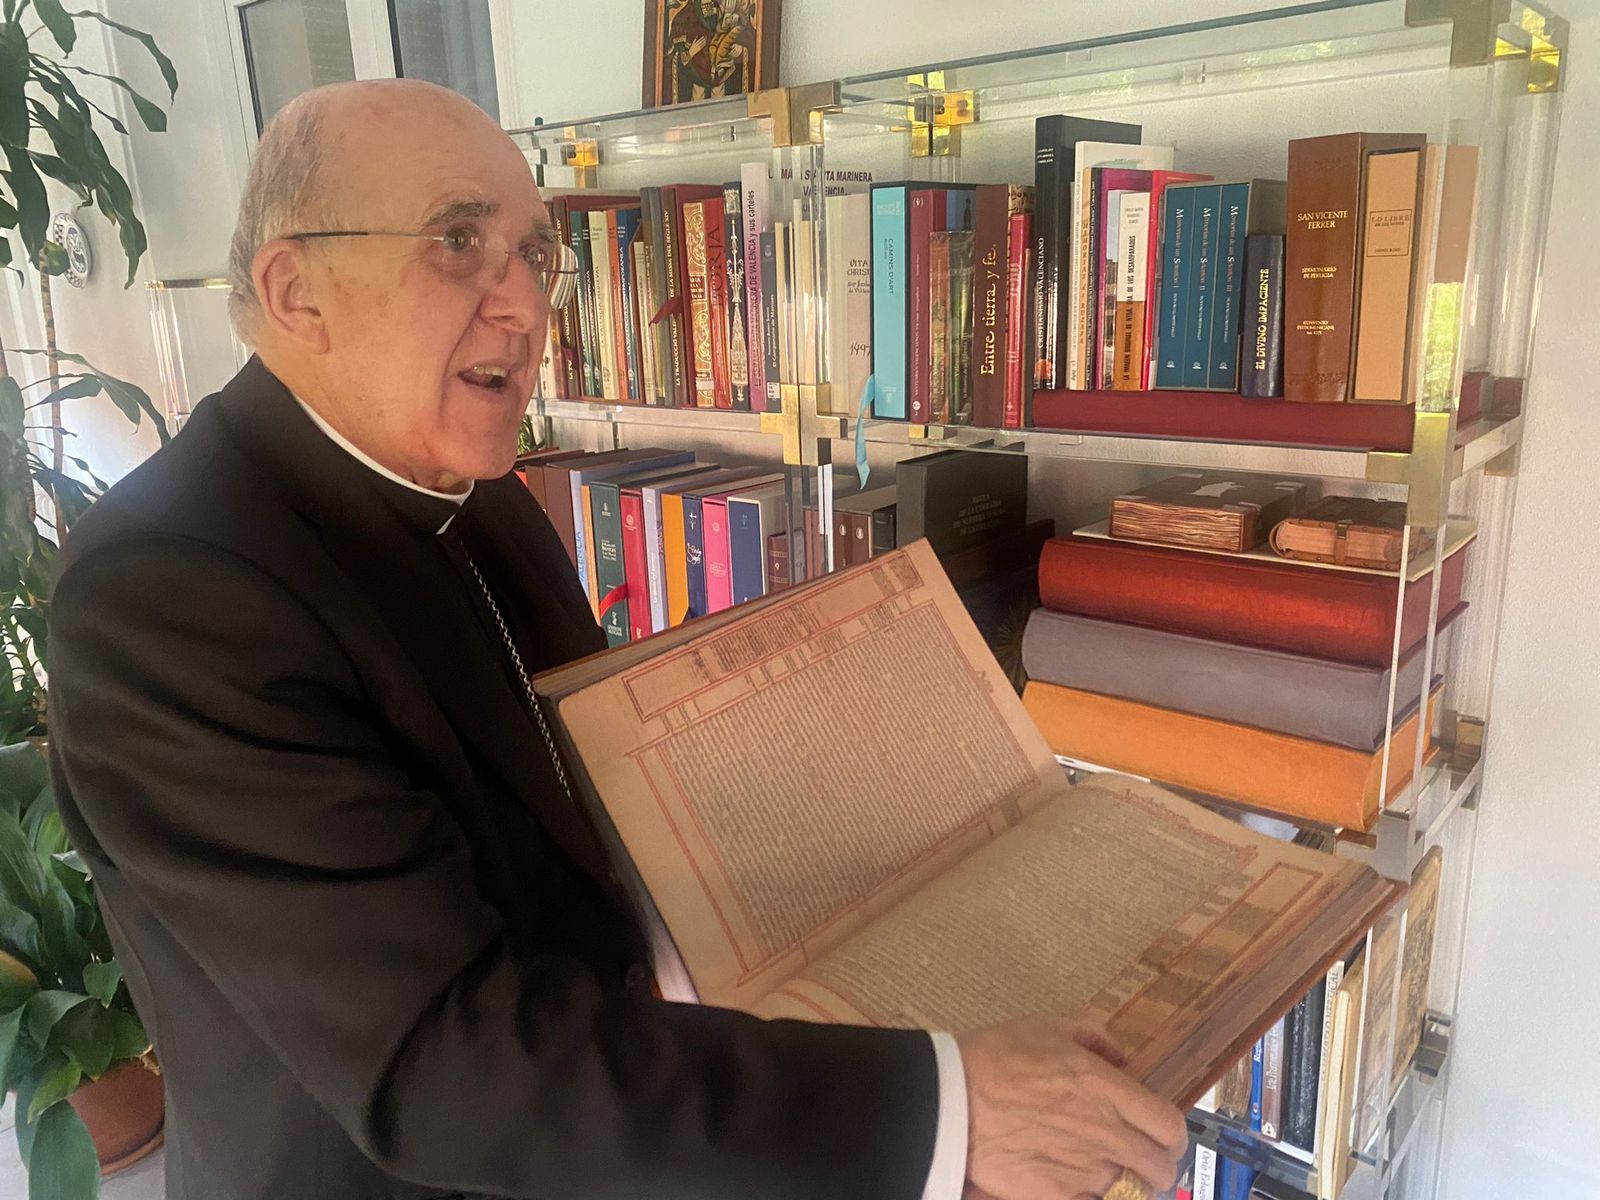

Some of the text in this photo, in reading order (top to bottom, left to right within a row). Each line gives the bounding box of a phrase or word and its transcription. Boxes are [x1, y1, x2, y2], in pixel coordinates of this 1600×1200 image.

[836, 170, 873, 182] MARINERA
[747, 190, 756, 217] carteles
[1297, 210, 1349, 222] SAN VICENTE
[1308, 219, 1337, 229] FERRER
[748, 239, 757, 274] VALENCIA
[1128, 235, 1137, 273] DESAMPARADOS
[707, 226, 725, 306] BORJA
[849, 259, 868, 267] VITA
[668, 279, 674, 287] LA
[749, 275, 757, 286] DE
[669, 289, 675, 297] DE
[1037, 237, 1045, 349] CRISTIANISMO VALENCIANO
[980, 243, 1000, 375] Entre tierra y fe.
[1255, 268, 1269, 370] EL DIVINO IMPACIENTE
[674, 378, 681, 386] LA
